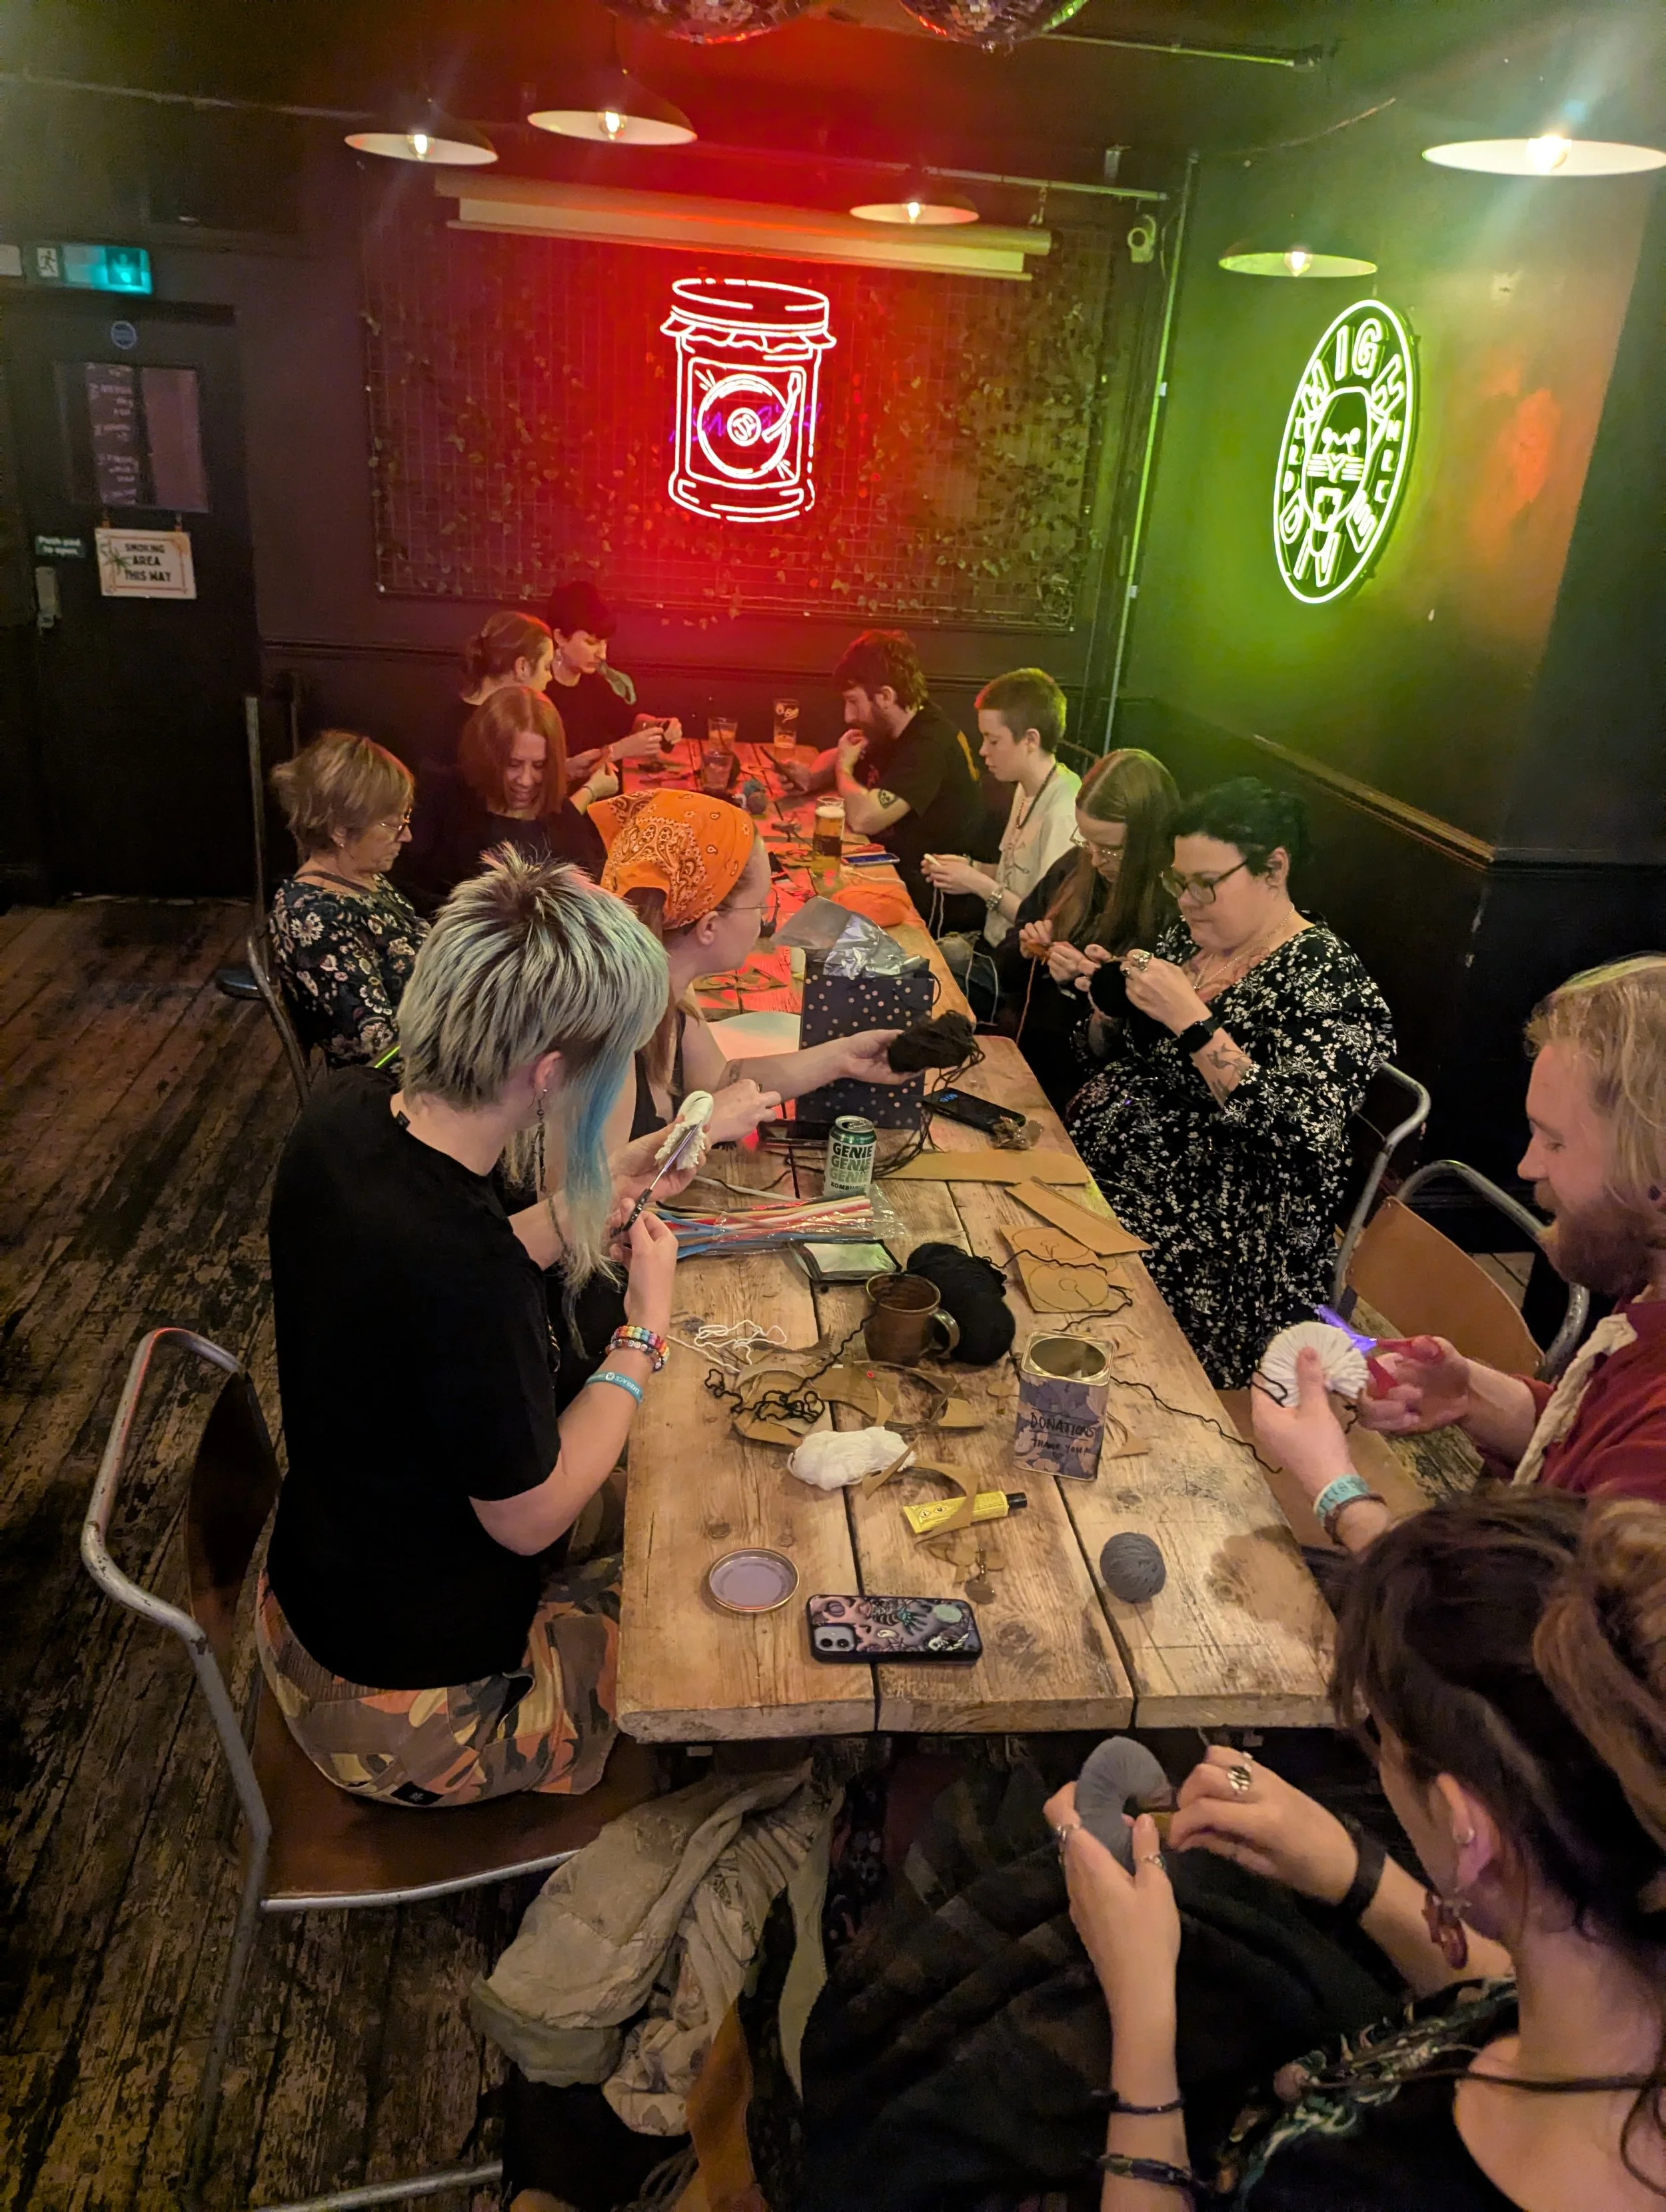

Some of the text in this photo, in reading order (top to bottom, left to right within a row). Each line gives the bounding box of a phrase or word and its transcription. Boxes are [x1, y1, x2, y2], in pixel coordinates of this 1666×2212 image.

[125, 543, 165, 554] SMOKING
[132, 555, 161, 567] AREA
[125, 569, 171, 582] THIS WAY
[832, 1142, 873, 1159] GENIE
[831, 1155, 872, 1171] GENIE
[830, 1167, 869, 1183] GENIE
[1030, 1412, 1096, 1436] DONATIONS
[1031, 1436, 1061, 1450] THANK
